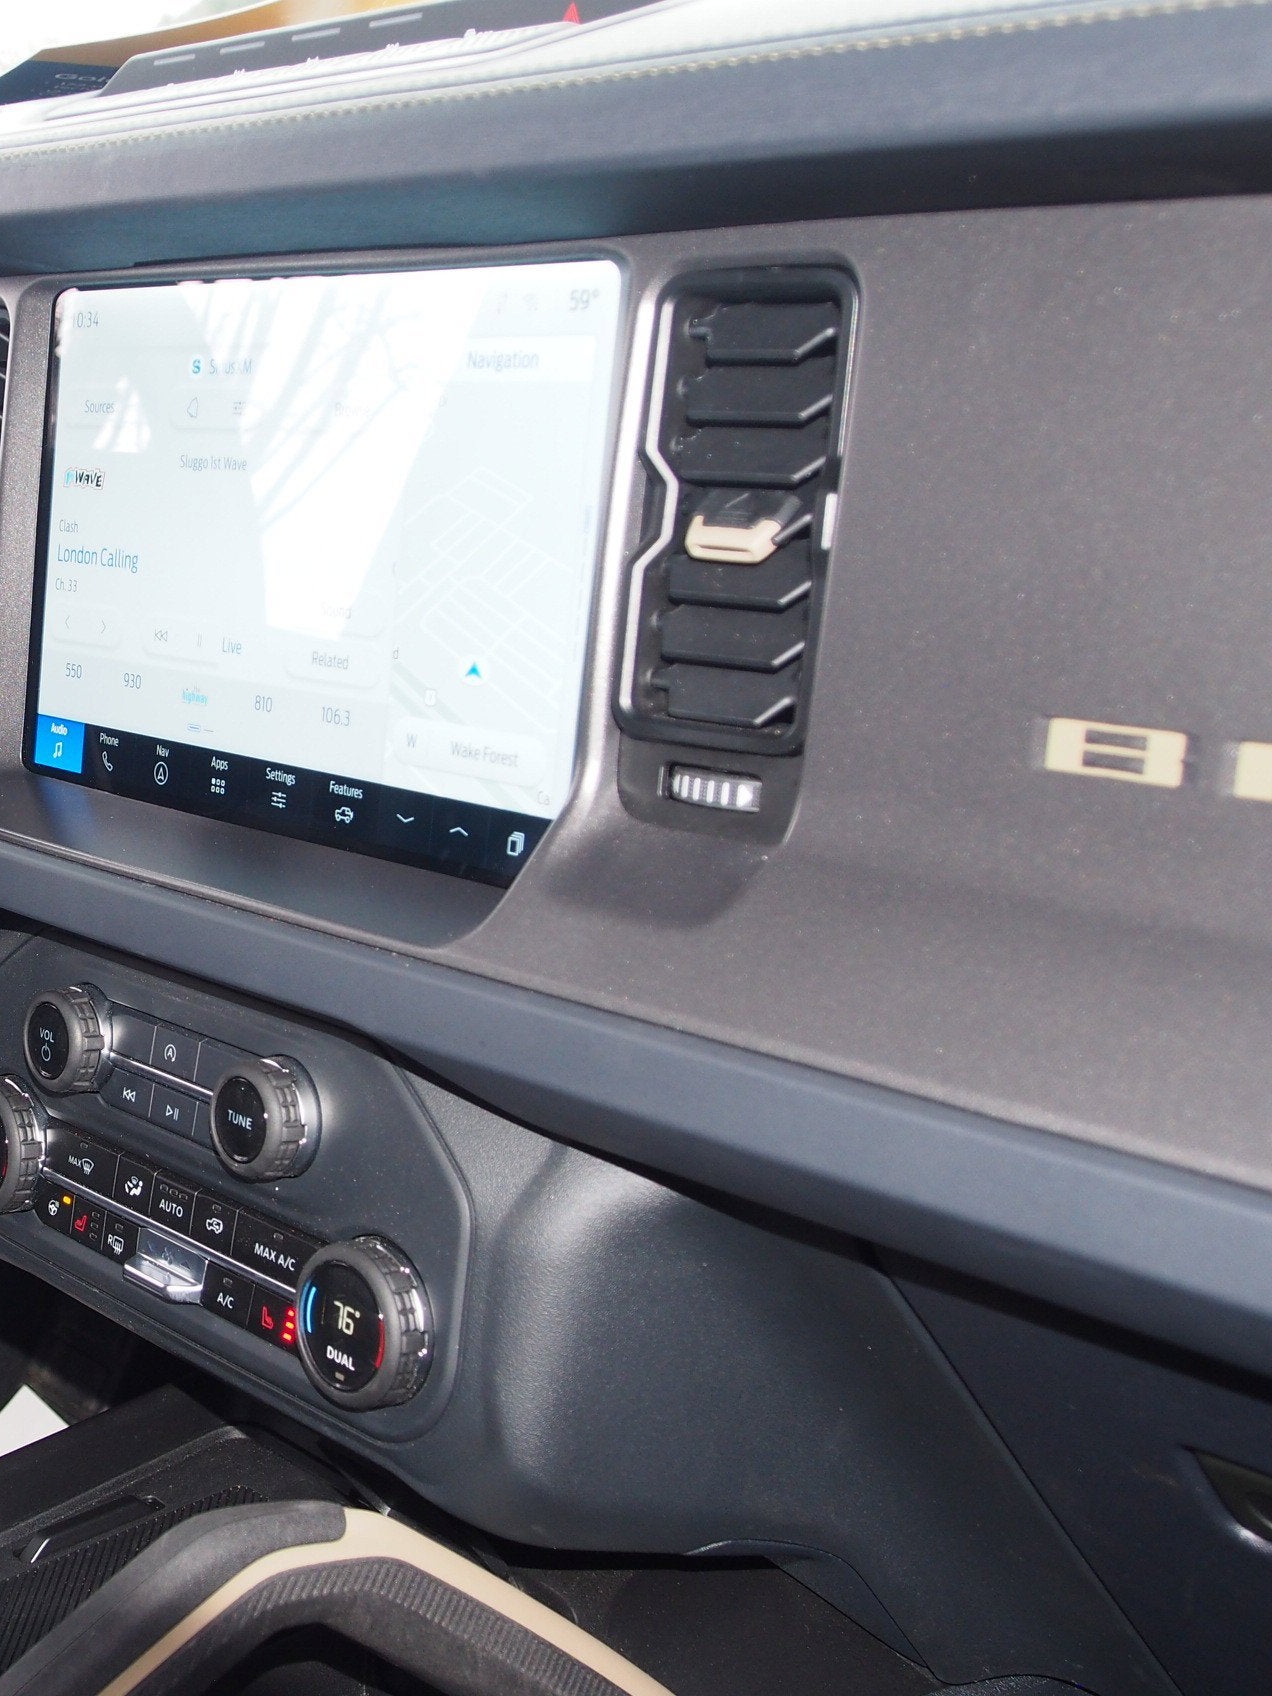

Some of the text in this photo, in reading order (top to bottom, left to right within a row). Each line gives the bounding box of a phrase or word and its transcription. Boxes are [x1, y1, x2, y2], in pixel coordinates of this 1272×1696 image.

[467, 350, 540, 372] Navigation
[84, 400, 116, 415] Sources
[180, 453, 208, 473] Sluggo
[223, 456, 248, 472] Wave
[58, 518, 79, 534] Clash
[56, 543, 139, 574] London Calling
[67, 578, 79, 593] 33
[222, 636, 243, 655] Live
[311, 650, 350, 671] Related
[64, 661, 83, 680] 550
[122, 671, 142, 690] 930
[253, 694, 273, 713] 810
[320, 705, 351, 727] 106.3
[50, 721, 68, 737] Audio
[99, 731, 119, 748] Phone
[406, 732, 418, 749] W
[155, 743, 170, 759] Nav
[449, 739, 520, 769] Wake Forest
[210, 755, 229, 772] Apps
[265, 766, 296, 786] Settings
[328, 780, 364, 800] Features
[39, 1026, 55, 1043] VOL
[227, 1108, 253, 1132] TUNE
[68, 1154, 82, 1168] MAX
[158, 1198, 184, 1218] AUTO
[254, 1242, 297, 1272] MAX A/C
[216, 1291, 235, 1310] A/C
[333, 1299, 361, 1336] 76°
[326, 1344, 356, 1372] DUAL
